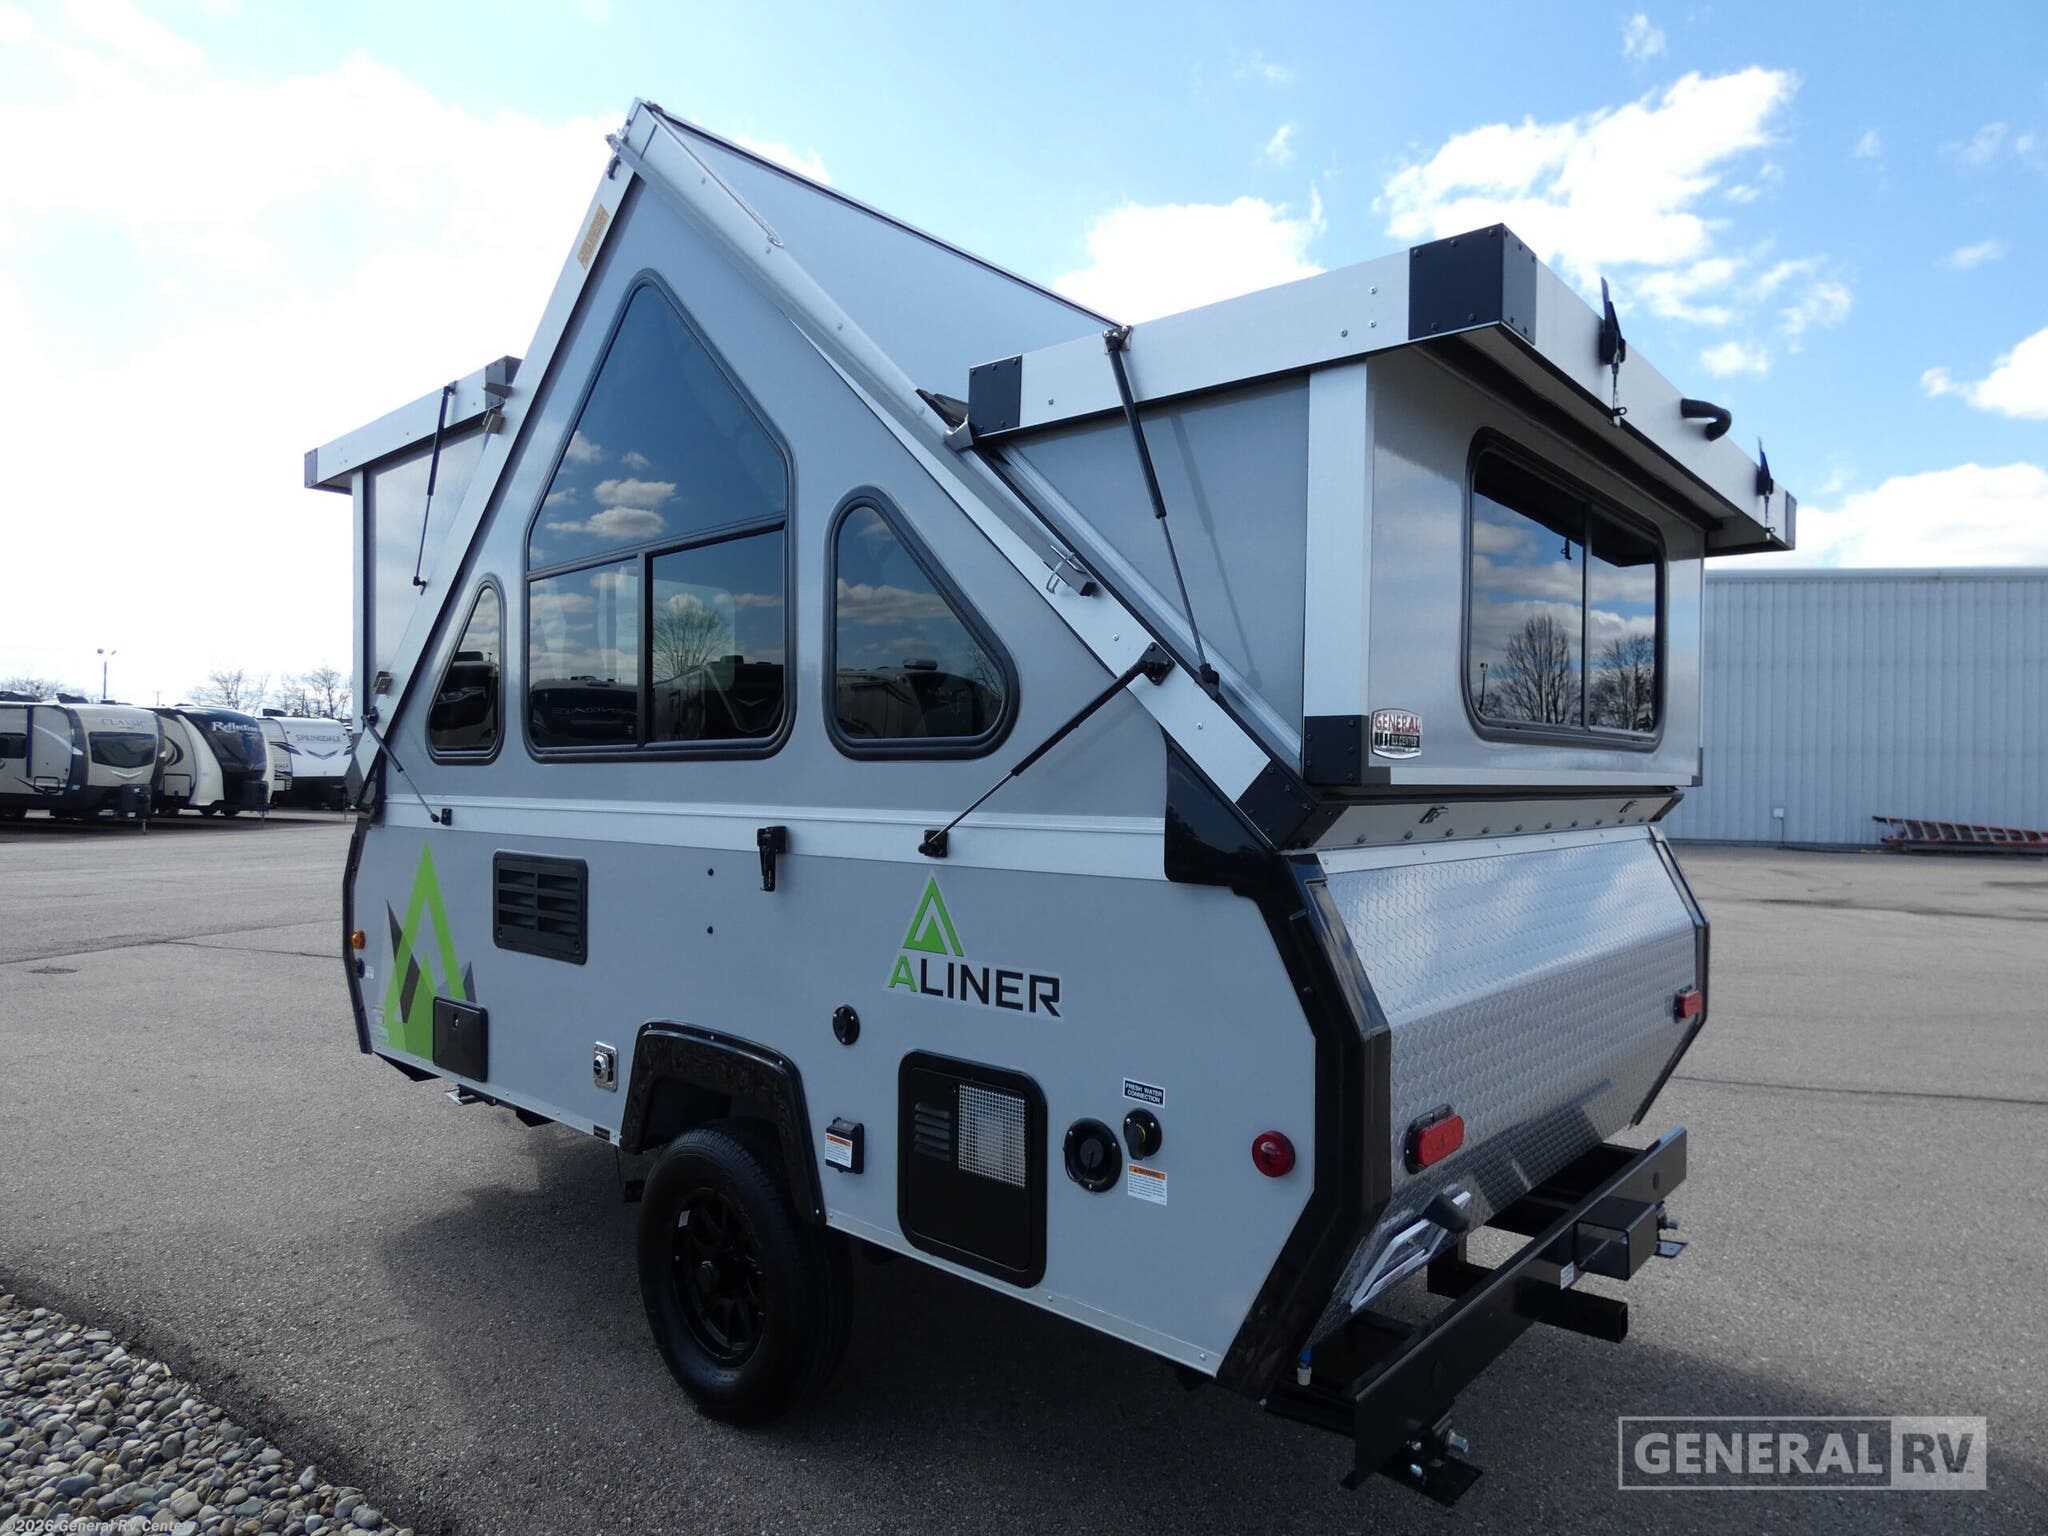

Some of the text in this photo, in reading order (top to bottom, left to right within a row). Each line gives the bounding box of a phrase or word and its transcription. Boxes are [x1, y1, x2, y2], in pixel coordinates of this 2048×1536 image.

[1375, 712, 1420, 733] GENERAL
[888, 955, 1061, 1017] ALINER
[1126, 1082, 1163, 1097] FRESH WATER
[1127, 1089, 1161, 1103] CONNECTION
